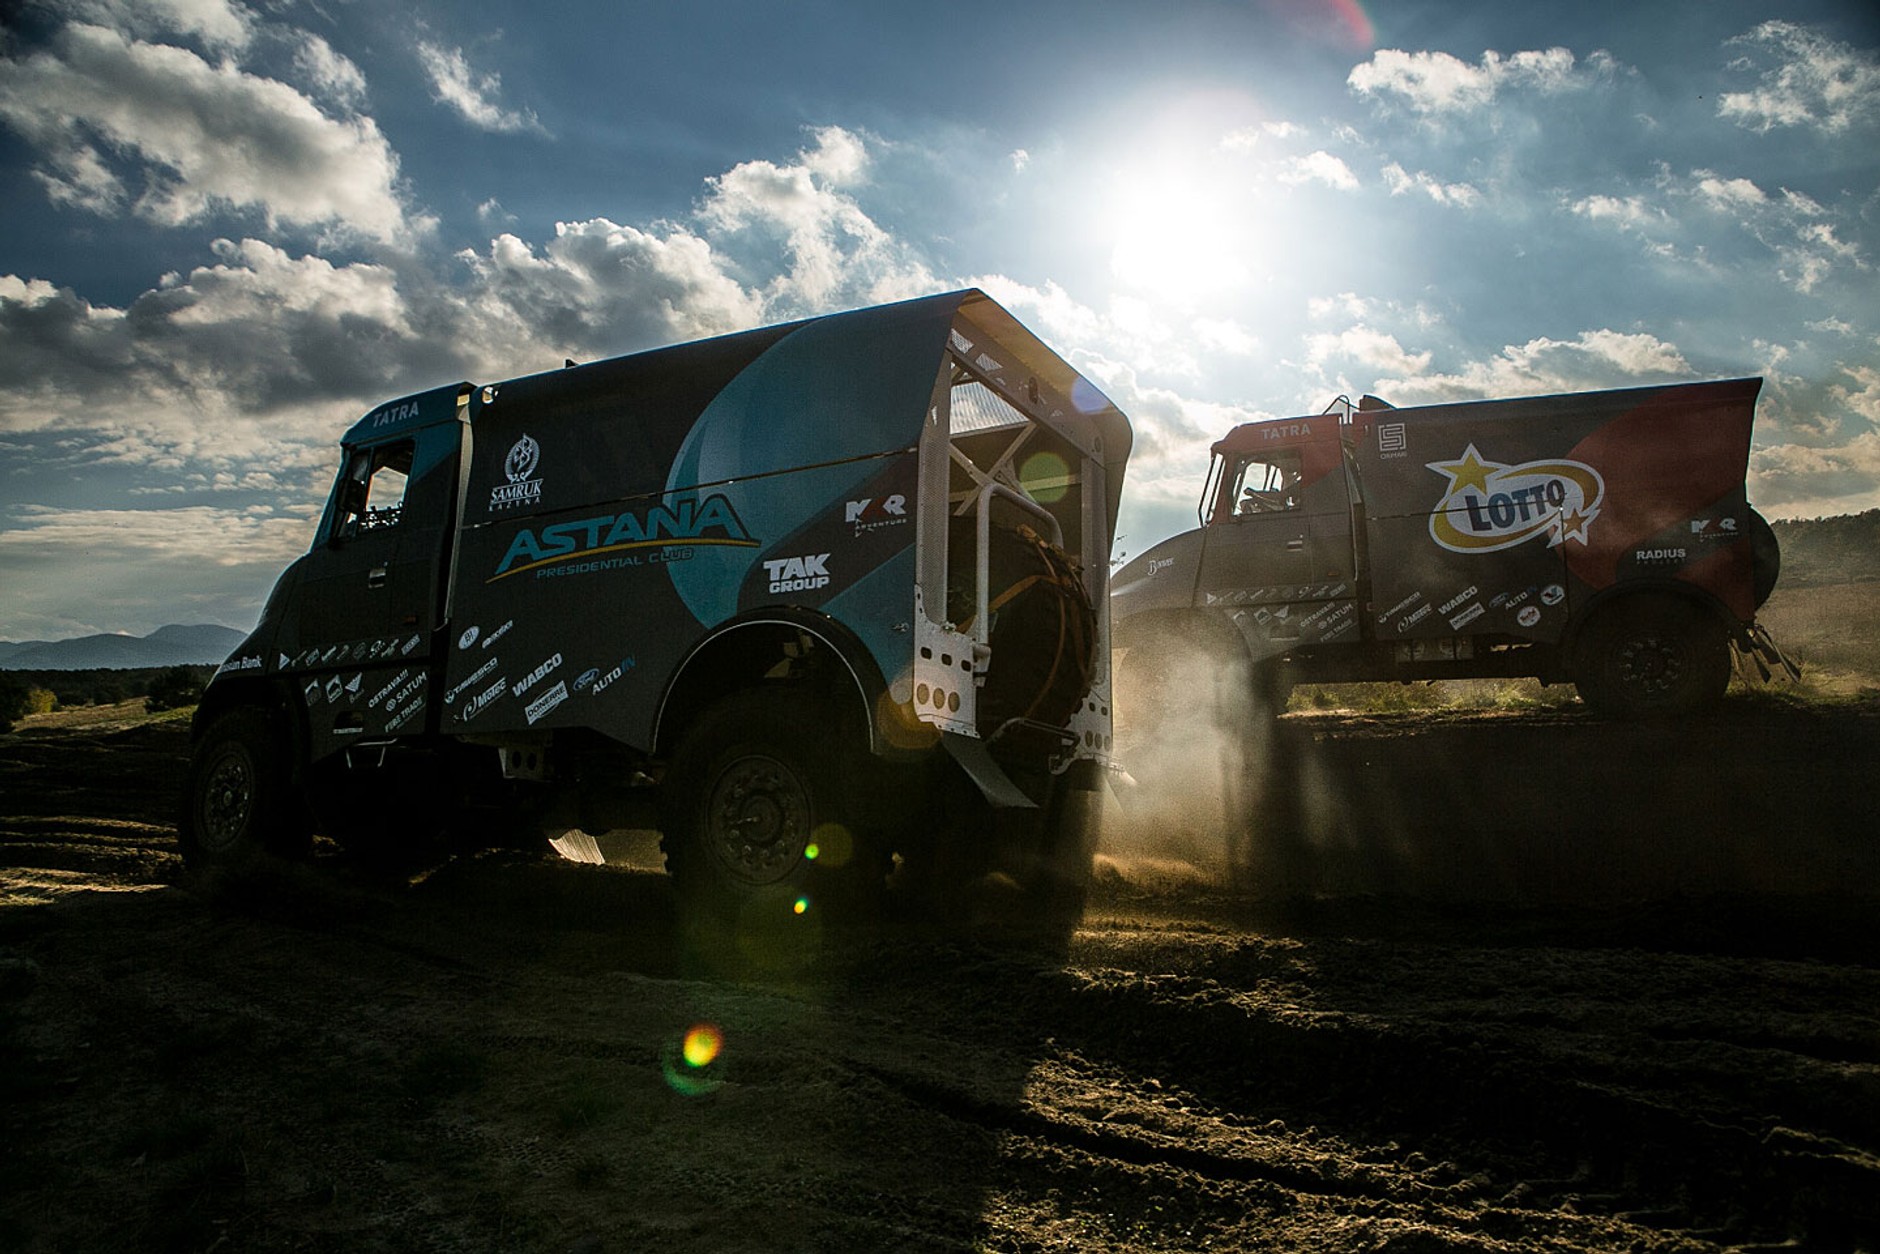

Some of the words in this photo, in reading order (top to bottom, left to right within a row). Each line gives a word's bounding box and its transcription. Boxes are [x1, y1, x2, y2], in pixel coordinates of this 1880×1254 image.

[373, 401, 419, 428] TATRA
[1262, 423, 1311, 440] TATRA
[490, 480, 542, 502] SAMRUK
[1465, 480, 1565, 532] LOTTO
[494, 493, 750, 575] ASTANA
[535, 555, 643, 580] PRESIDENTIAL
[648, 547, 695, 565] CLUB
[763, 552, 832, 582] TAK
[1636, 548, 1687, 560] RADIUS
[769, 575, 831, 595] GROUP
[396, 670, 428, 703] SATUM
[511, 651, 563, 698] WABCO
